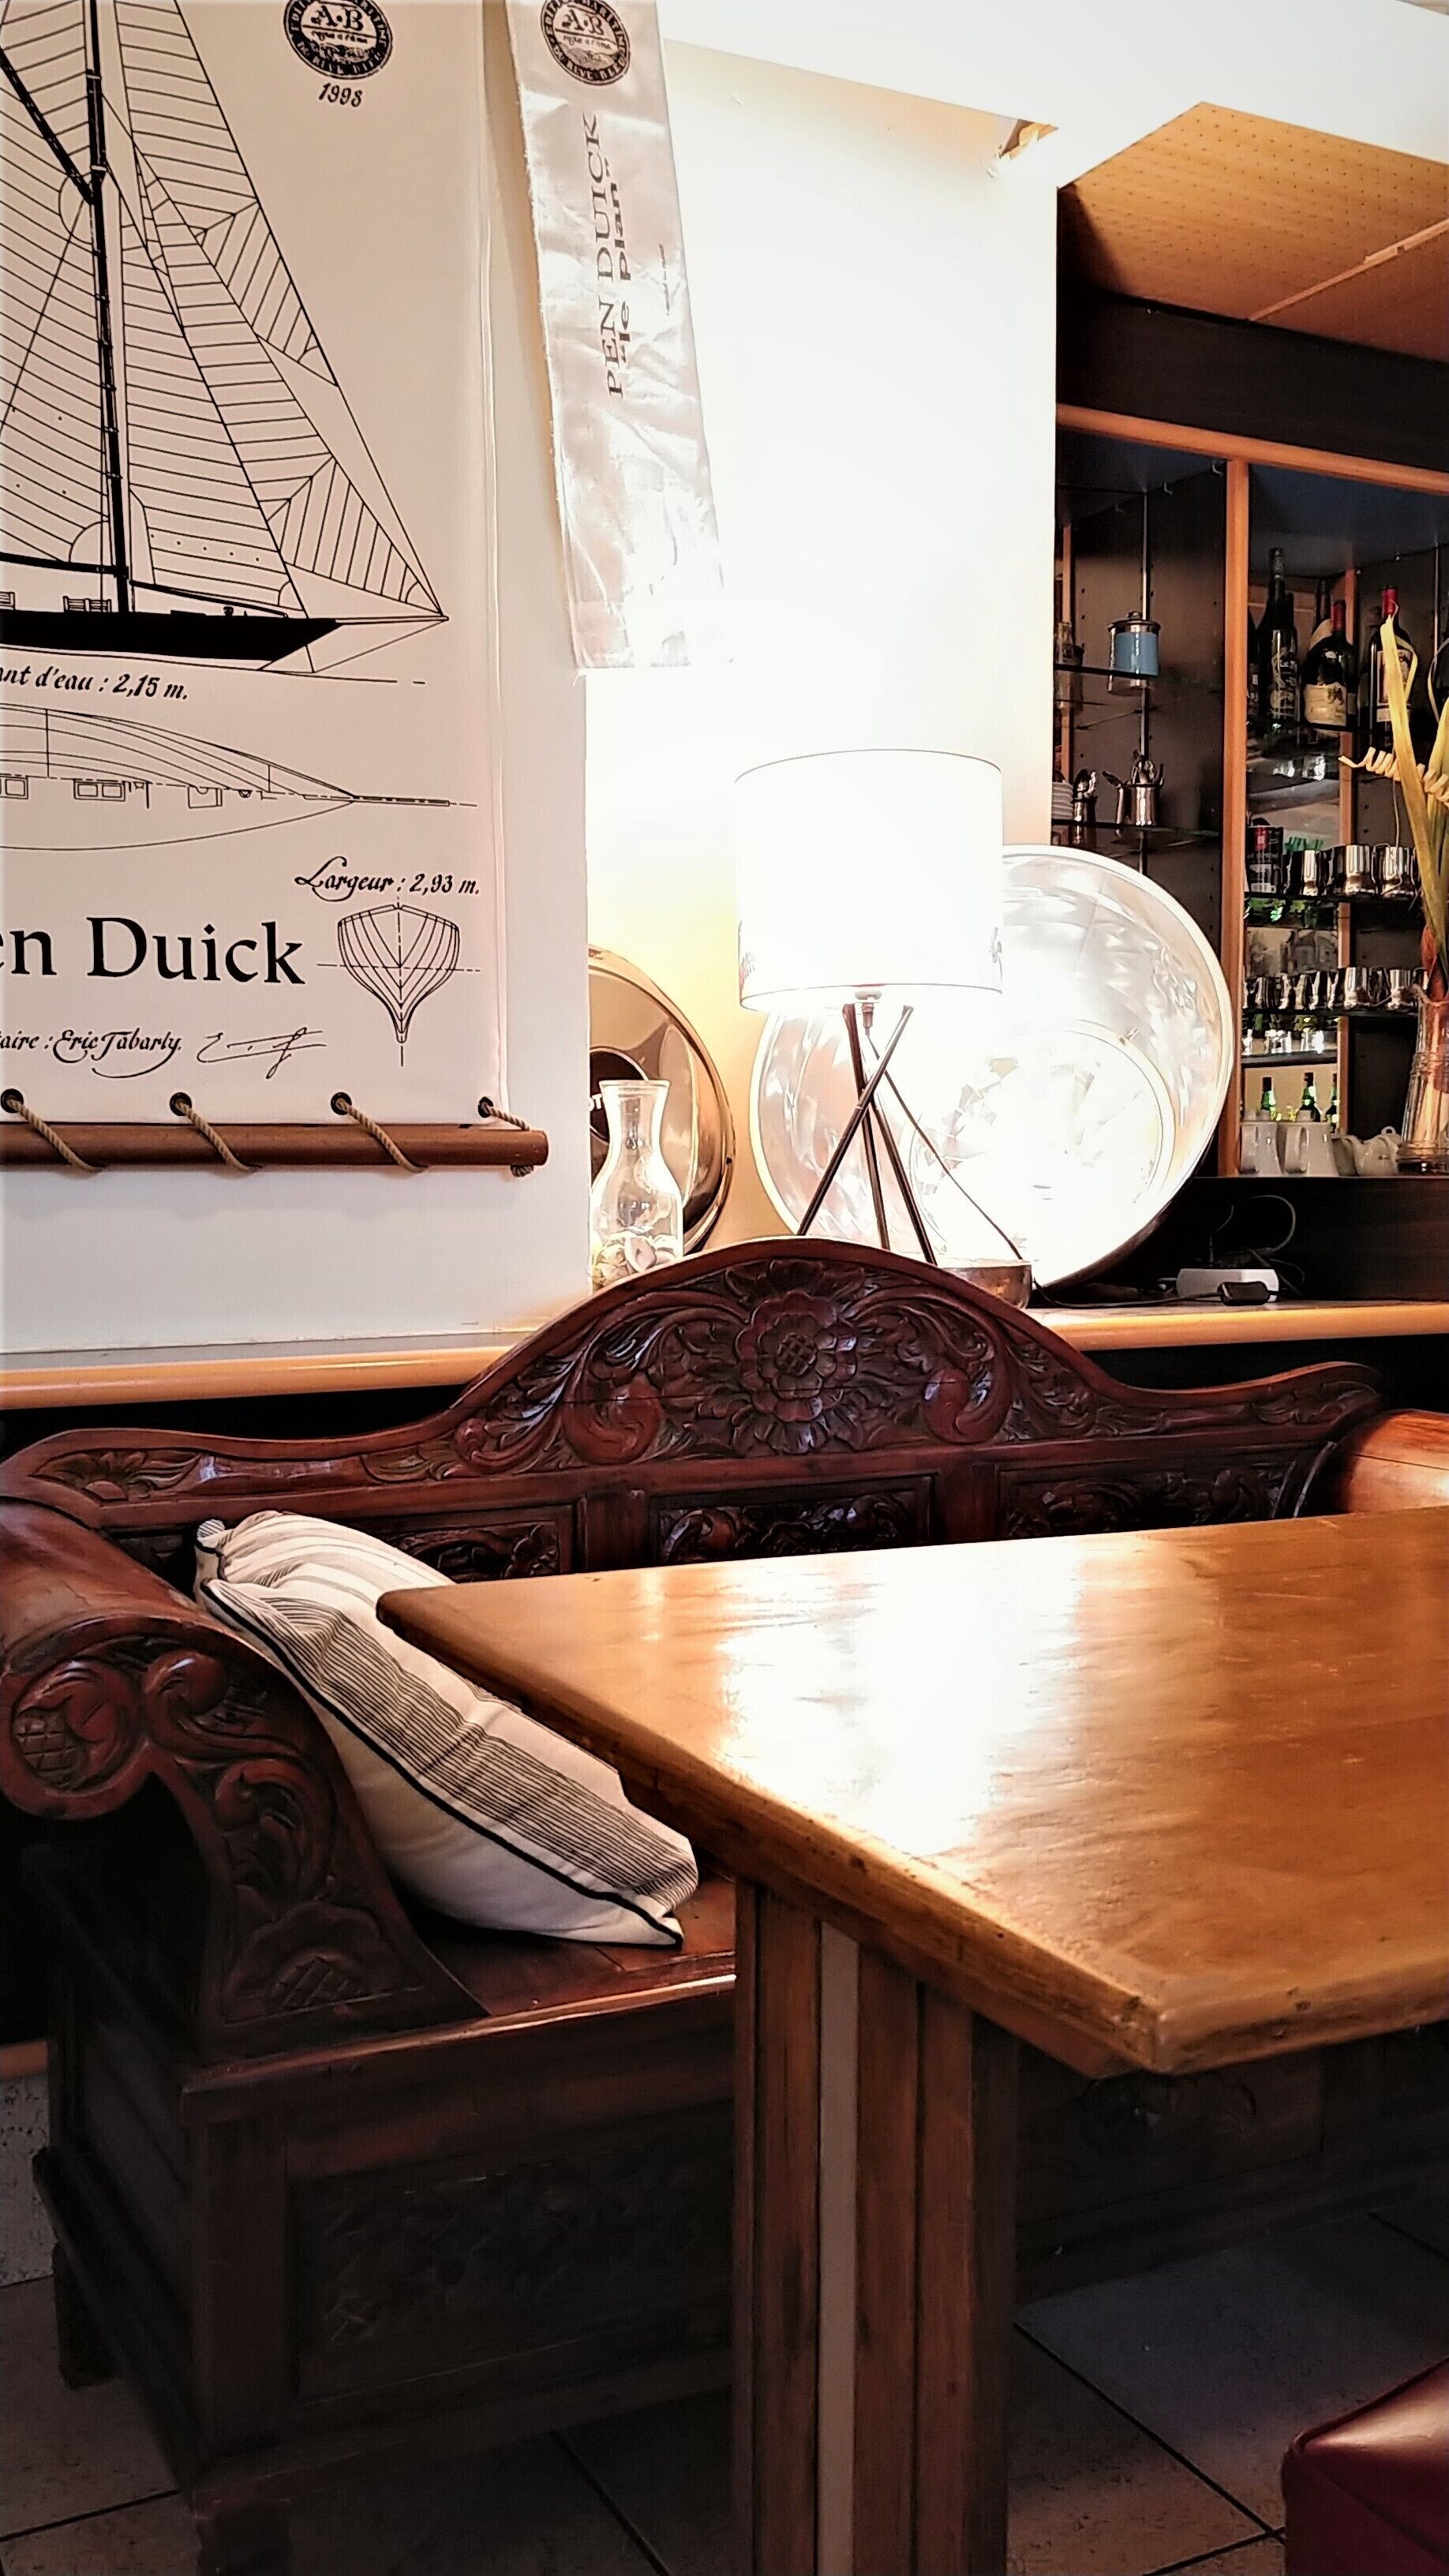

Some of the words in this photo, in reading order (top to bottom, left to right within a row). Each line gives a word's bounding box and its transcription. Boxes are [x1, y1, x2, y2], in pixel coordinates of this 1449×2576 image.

[318, 82, 363, 107] 1998
[582, 110, 614, 283] DUICK
[598, 295, 623, 399] PEN
[112, 673, 161, 698] 2,15
[163, 683, 189, 700] m.
[294, 856, 395, 902] Largeur
[409, 873, 454, 896] 2,93
[458, 879, 481, 895] m.
[85, 916, 306, 985] Duick
[53, 1029, 99, 1063] Eric
